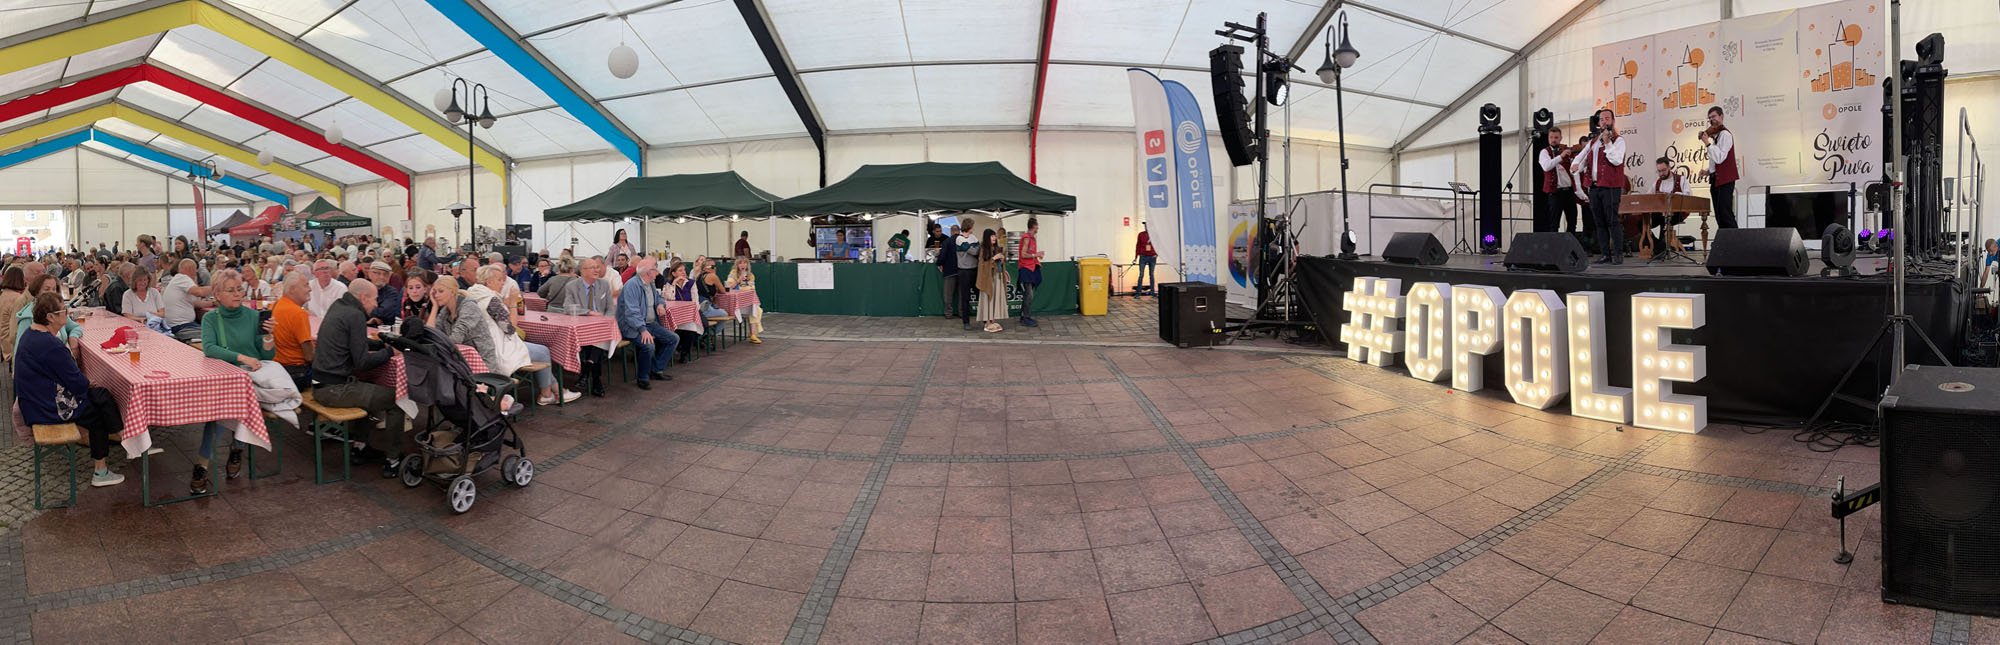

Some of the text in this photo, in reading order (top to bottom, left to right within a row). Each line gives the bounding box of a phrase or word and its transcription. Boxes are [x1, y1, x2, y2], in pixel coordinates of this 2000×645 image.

[1684, 120, 1705, 129] OPOLE
[1838, 105, 1862, 113] OPOLE
[1813, 127, 1872, 161] Święto
[1822, 153, 1873, 181] Piwa
[1188, 157, 1202, 209] OPOLE
[1340, 276, 1708, 434] #OPOLE
